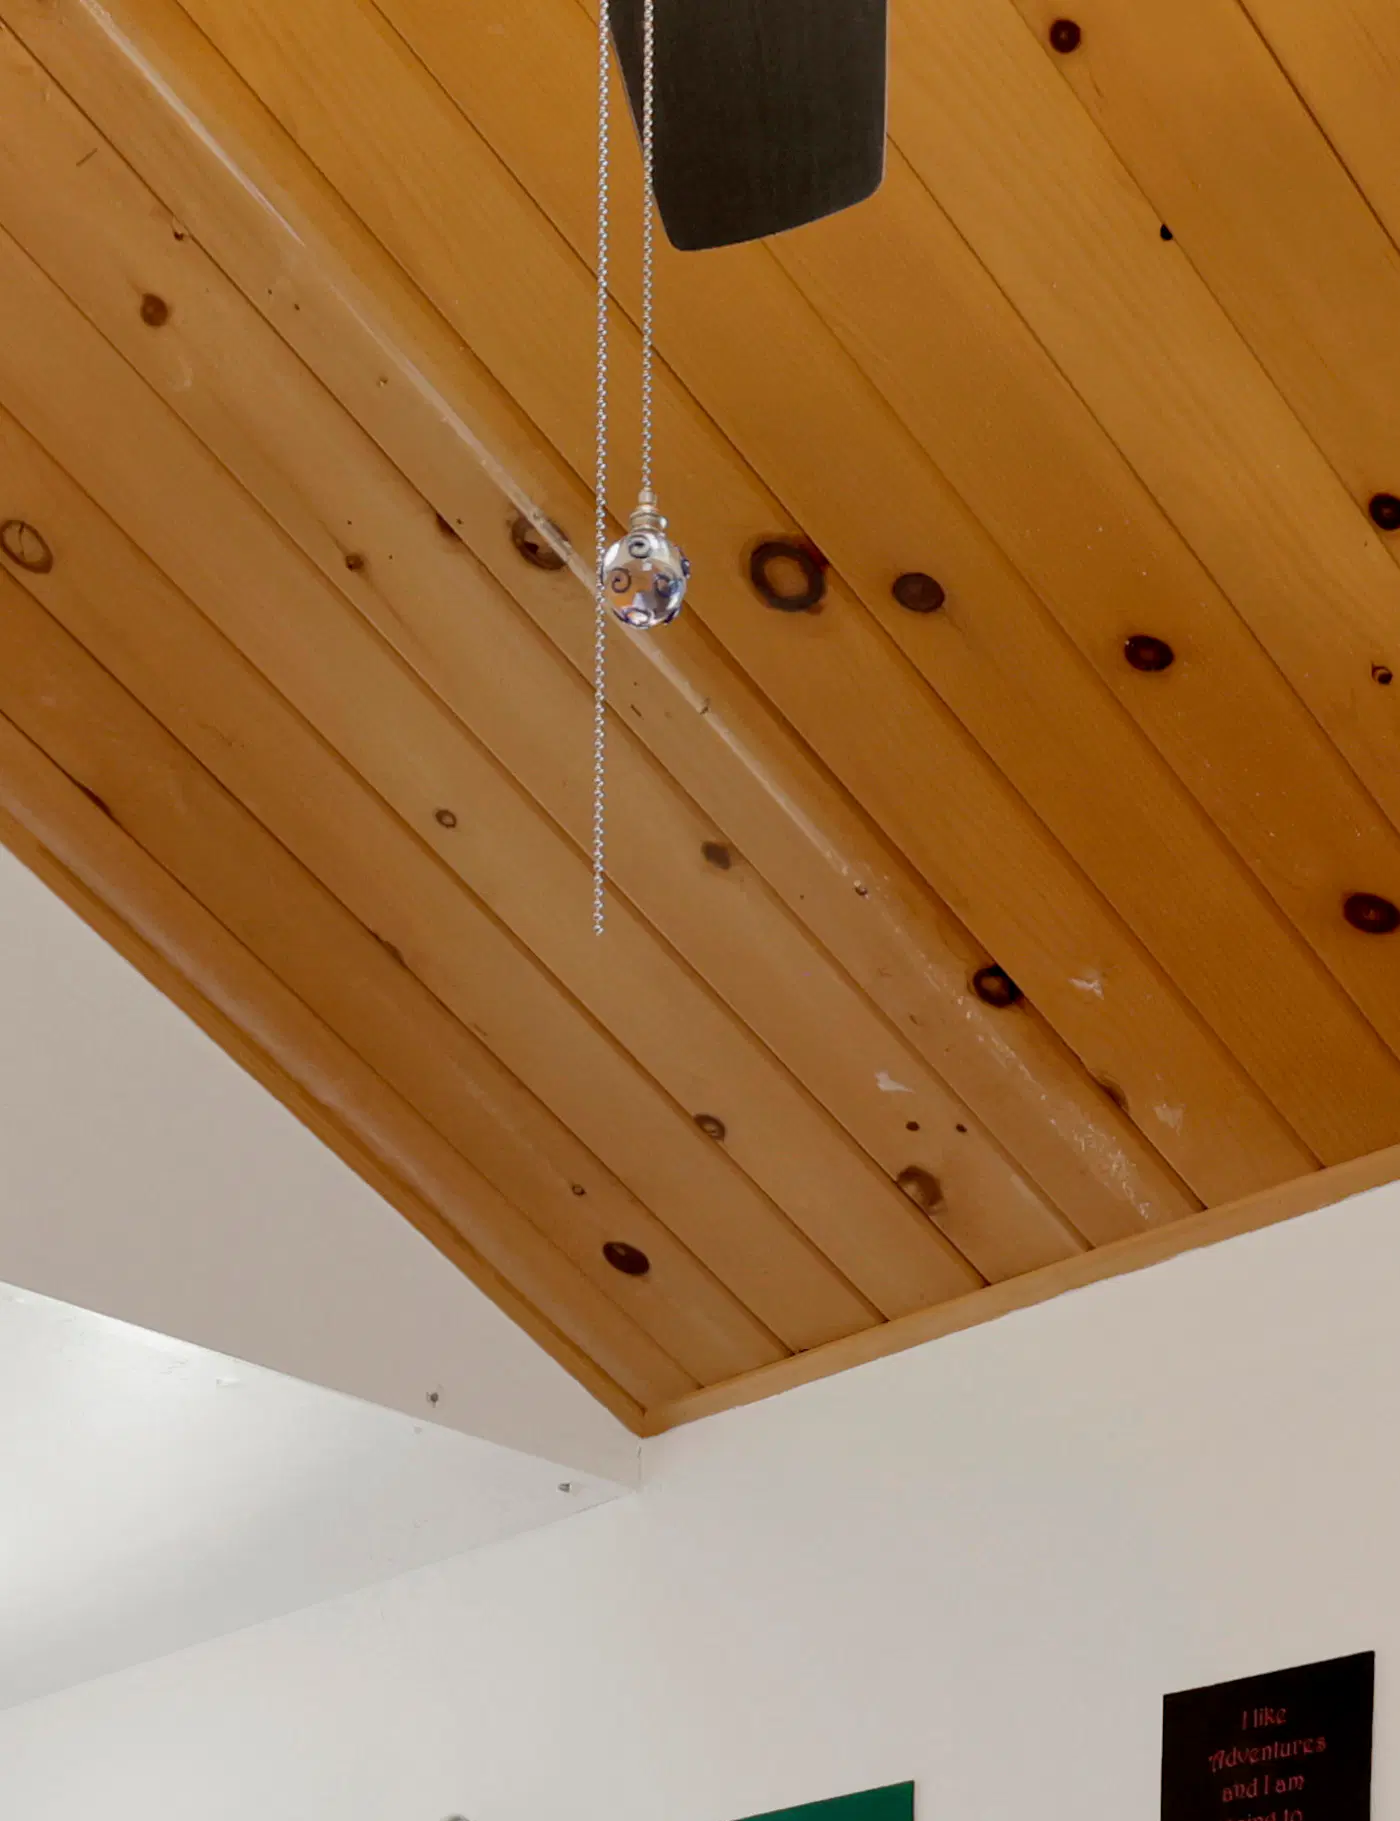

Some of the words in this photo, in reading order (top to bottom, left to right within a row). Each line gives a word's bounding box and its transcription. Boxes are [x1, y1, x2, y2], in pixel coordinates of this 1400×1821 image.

[1241, 1710, 1248, 1731] I
[1253, 1704, 1287, 1728] like
[1208, 1736, 1327, 1773] Adventures
[1222, 1777, 1258, 1803] and
[1264, 1774, 1270, 1796] I
[1275, 1774, 1305, 1794] am
